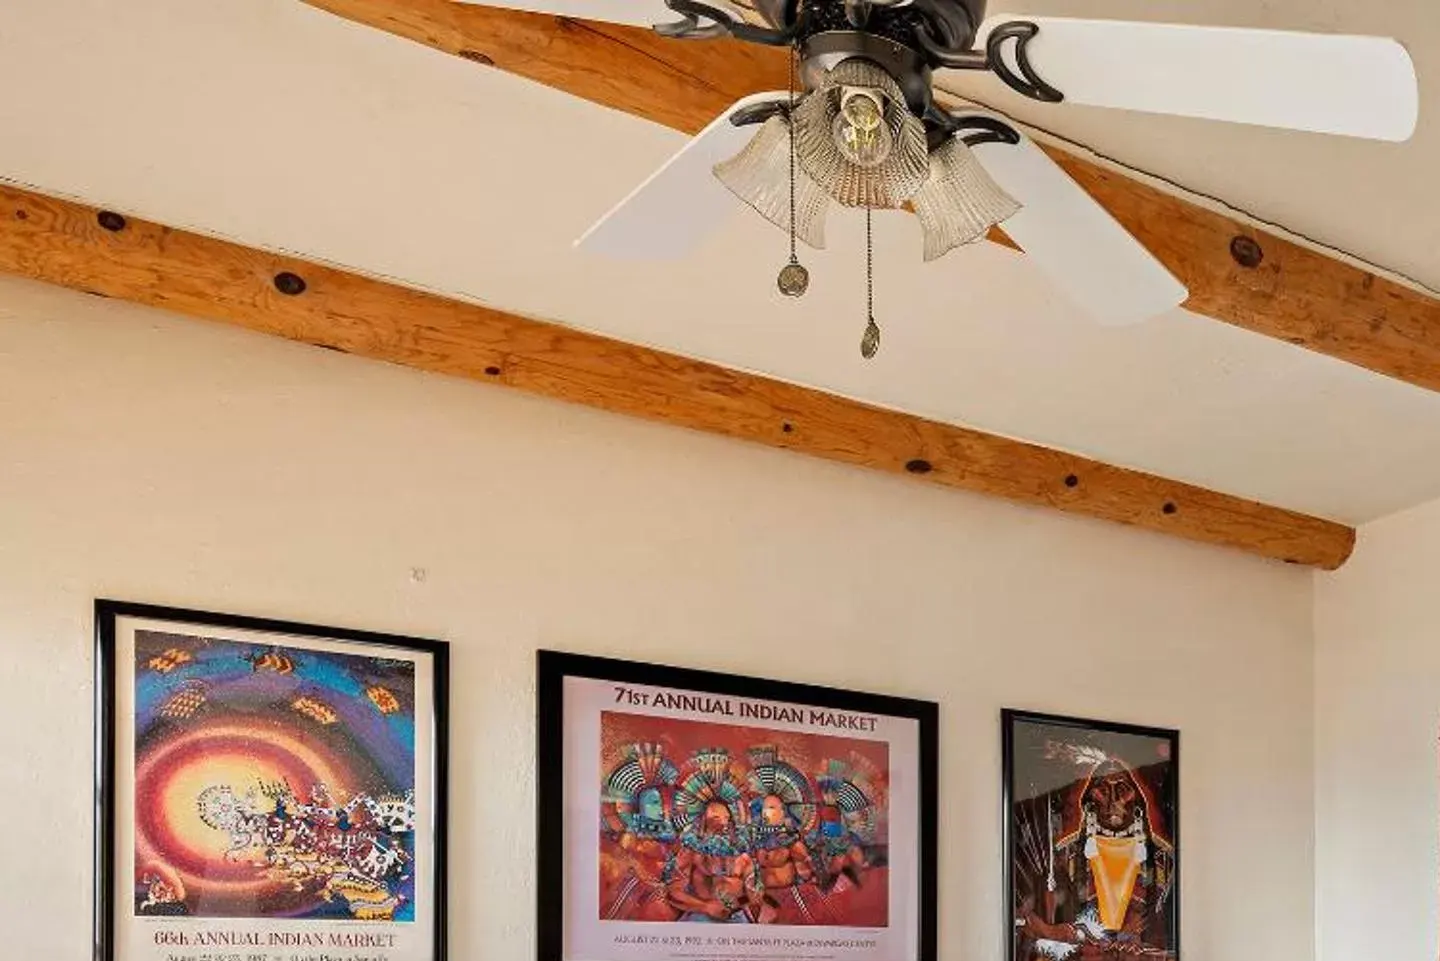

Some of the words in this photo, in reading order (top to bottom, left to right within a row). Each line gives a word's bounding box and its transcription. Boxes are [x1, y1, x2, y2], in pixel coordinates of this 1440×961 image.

[652, 692, 734, 715] ANNUAL
[739, 702, 804, 724] INDIAN
[809, 711, 877, 731] MARKET
[154, 931, 189, 945] 66th
[194, 931, 265, 946] ANNUAL
[268, 931, 324, 946] INDIAN
[327, 932, 398, 947] MARKET
